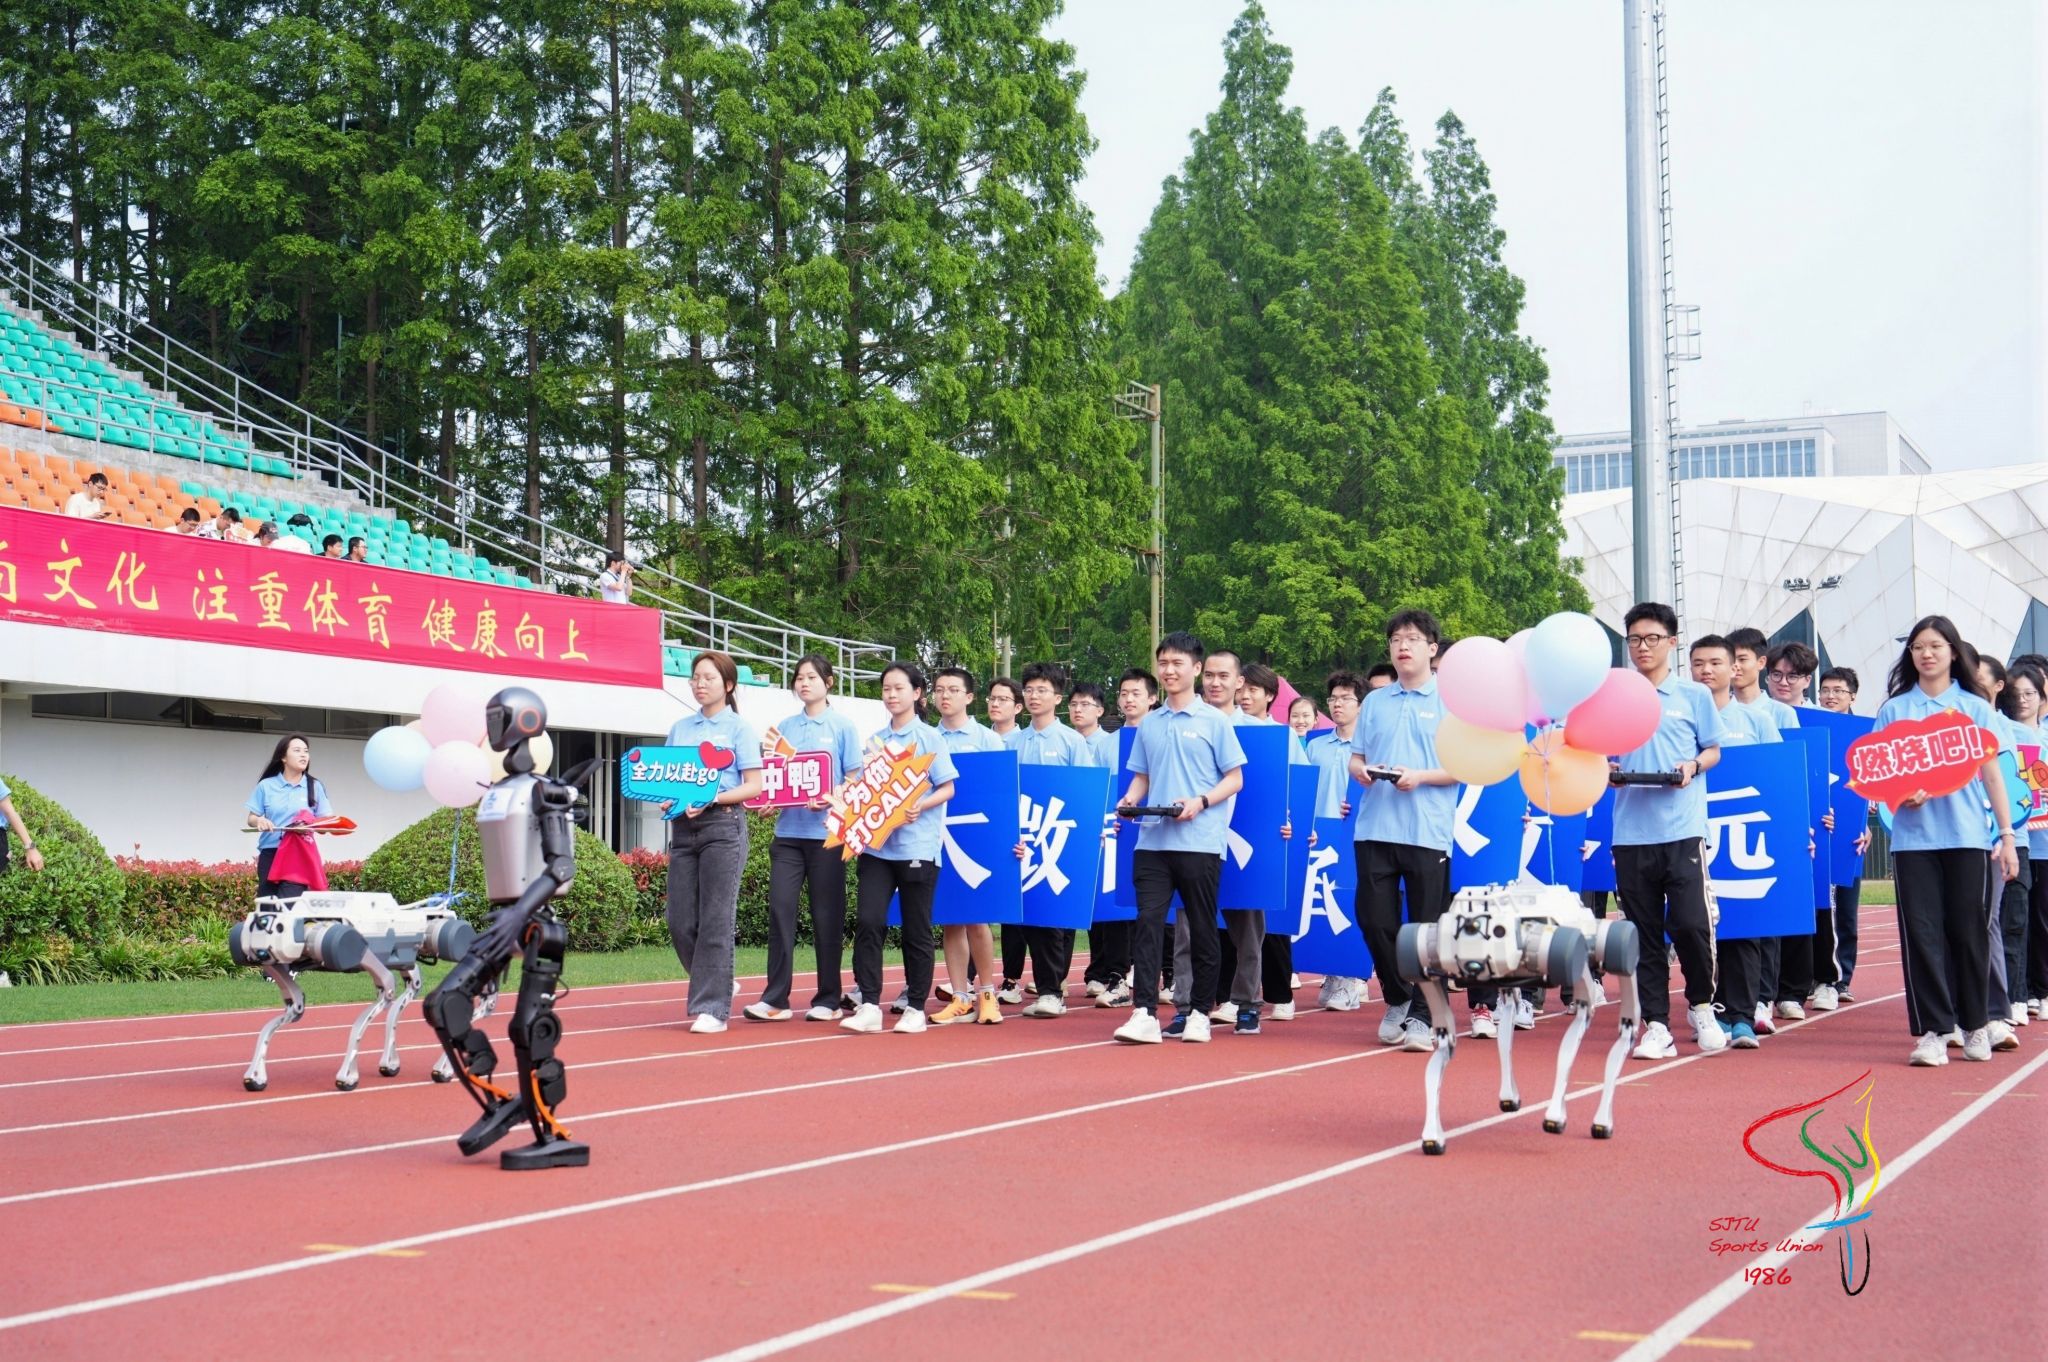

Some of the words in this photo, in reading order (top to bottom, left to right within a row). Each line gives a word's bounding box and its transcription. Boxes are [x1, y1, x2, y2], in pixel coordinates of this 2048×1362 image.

[193, 567, 394, 649] 注重体育
[421, 599, 590, 662] 健康向上
[1853, 725, 1985, 784] 燃烧吧！
[843, 755, 894, 815] 为你
